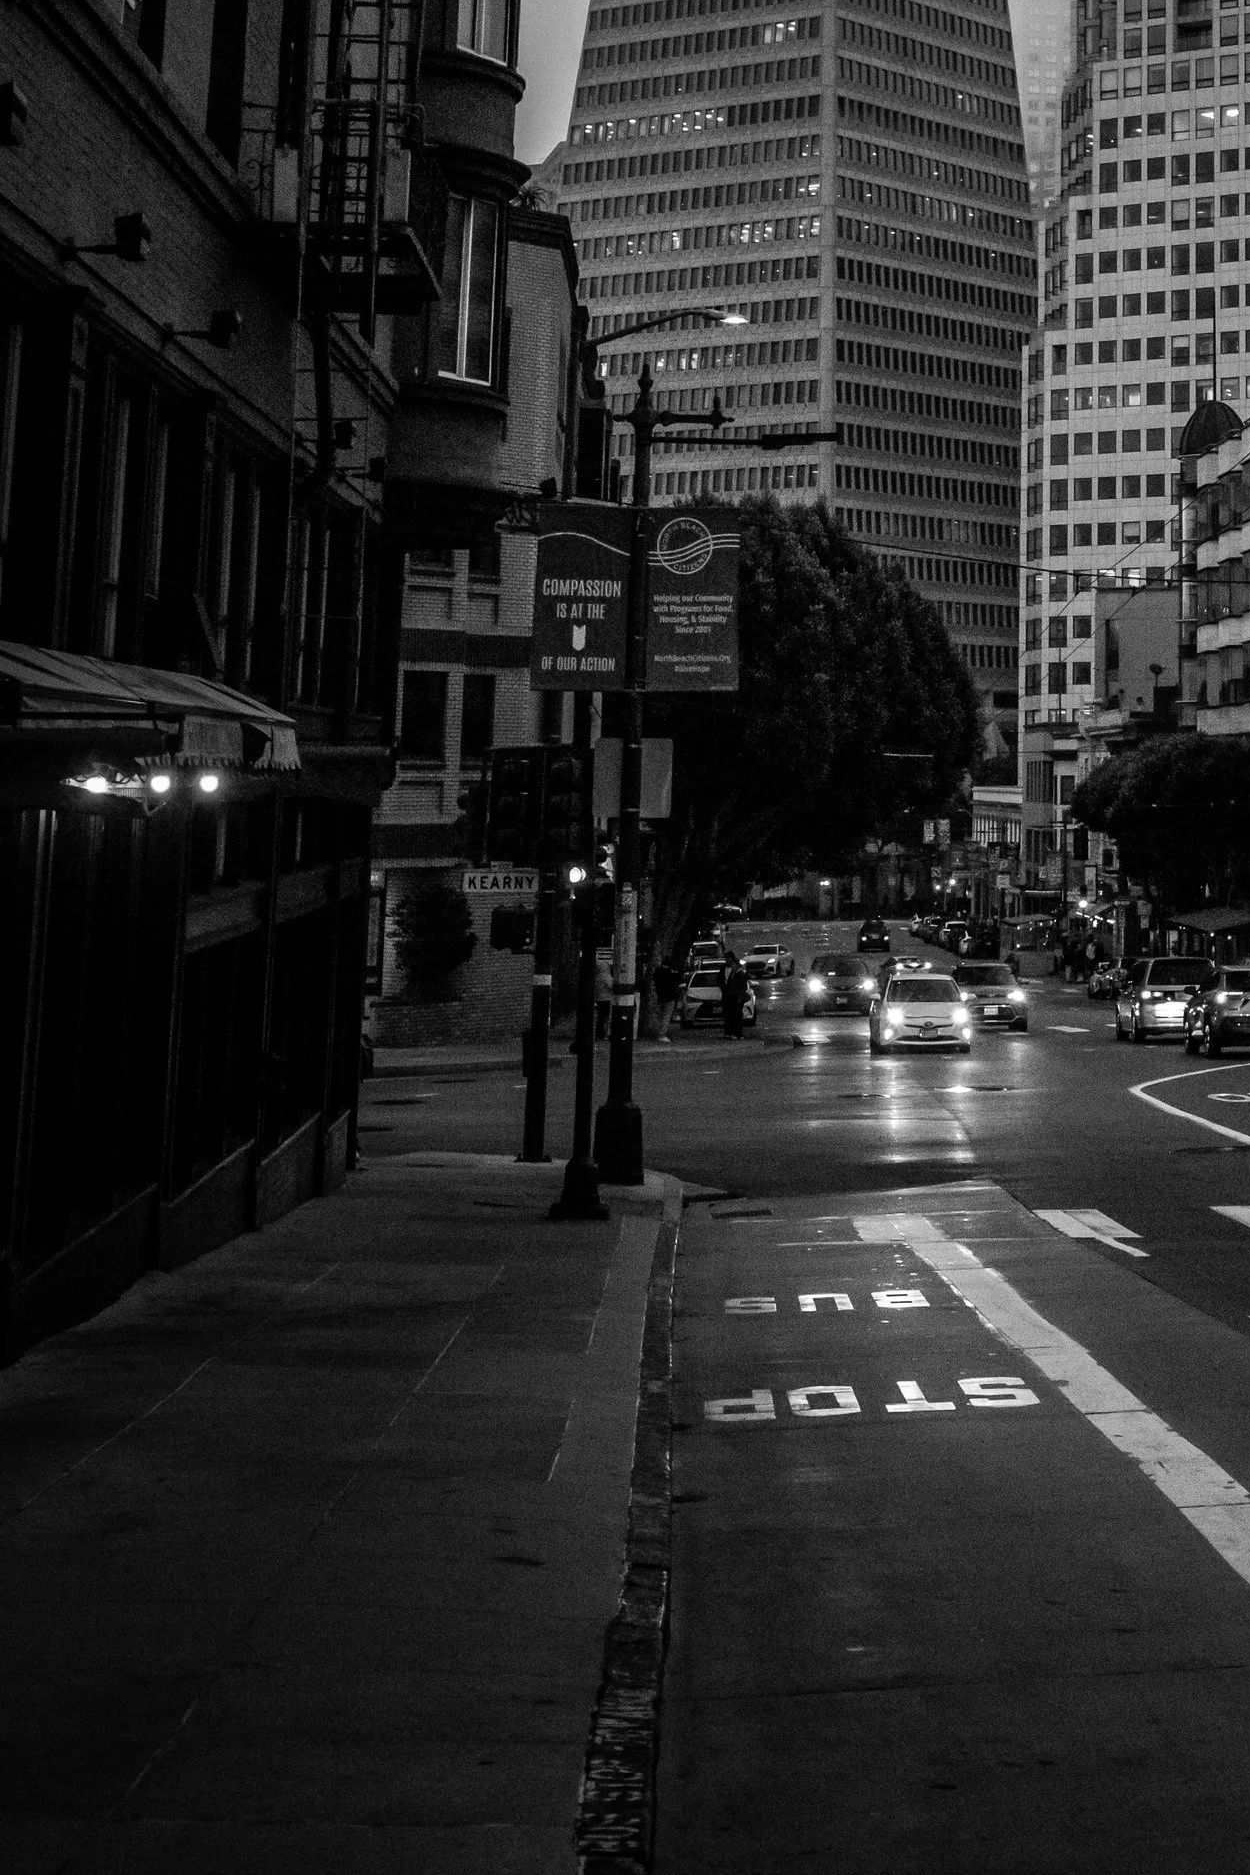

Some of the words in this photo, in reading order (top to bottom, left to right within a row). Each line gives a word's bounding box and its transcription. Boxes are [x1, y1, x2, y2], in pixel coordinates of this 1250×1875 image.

[542, 578, 622, 598] COMPASSION
[653, 594, 681, 603] Helping
[695, 593, 734, 603] Community
[556, 602, 567, 619] IS
[570, 602, 583, 619] AT
[586, 603, 606, 620] THE
[652, 604, 668, 613] with
[669, 605, 702, 614] Programs
[703, 604, 714, 613] for
[698, 614, 728, 625] Stability
[674, 625, 694, 634] Since
[694, 625, 712, 634] 2001
[541, 656, 554, 671] OF
[556, 656, 577, 671] OUR
[580, 656, 616, 672] ACTION
[468, 875, 535, 890] KEARNY
[723, 1289, 931, 1314] BUS
[703, 1376, 1041, 1423] STOP
